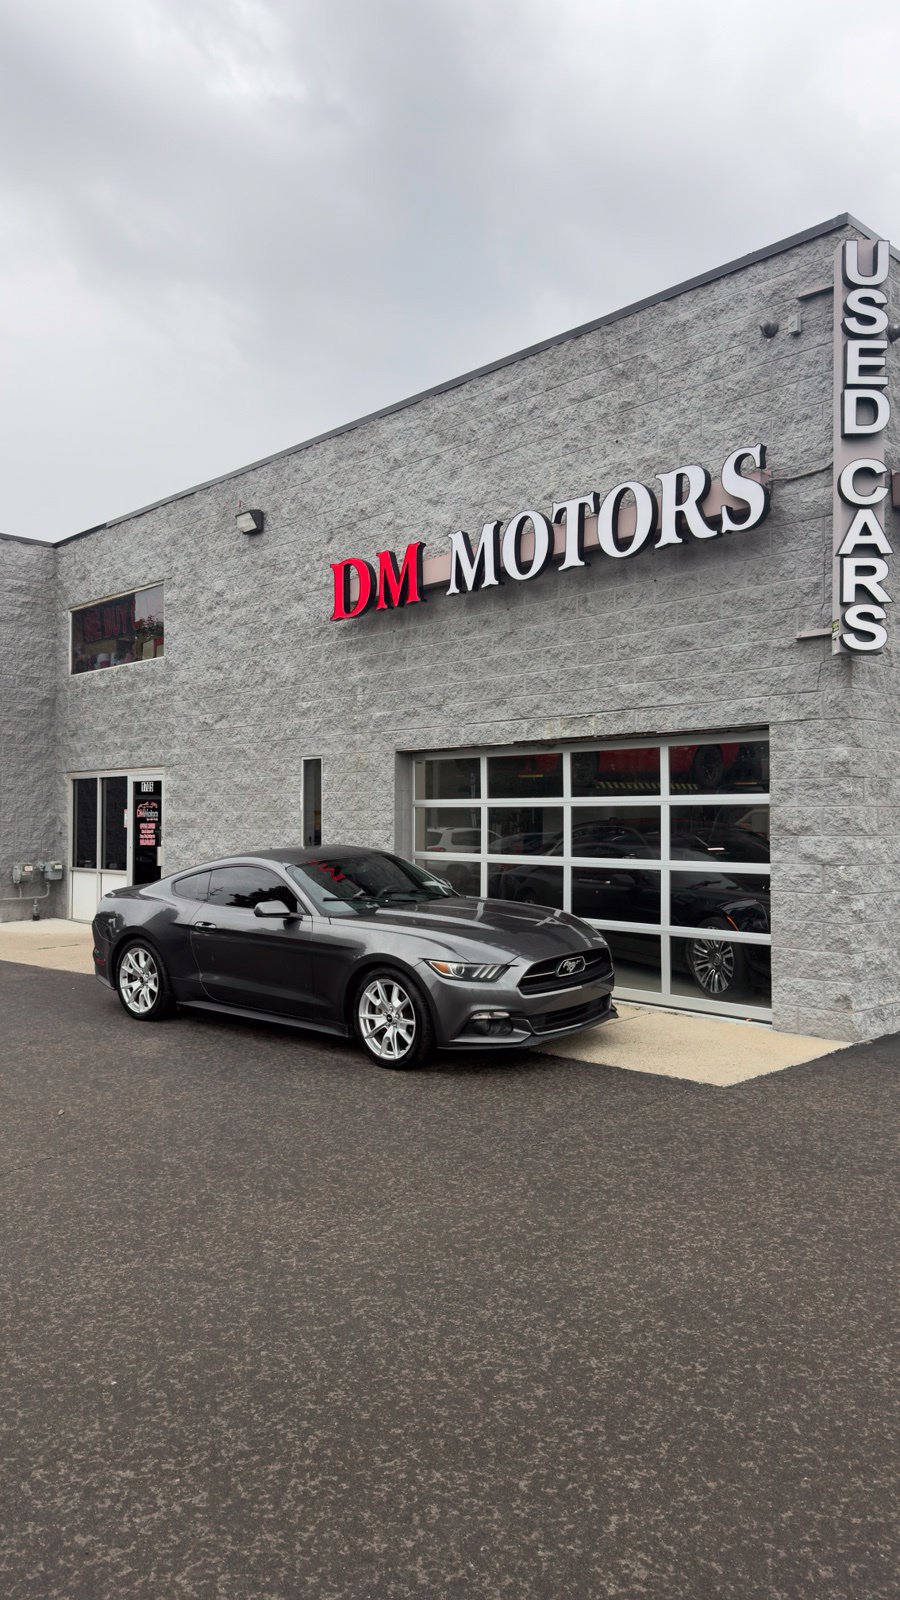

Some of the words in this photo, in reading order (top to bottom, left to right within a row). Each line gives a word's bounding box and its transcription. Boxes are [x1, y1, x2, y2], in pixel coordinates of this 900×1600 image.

[843, 240, 891, 435] USED
[330, 541, 426, 622] DM
[446, 443, 770, 596] MOTORS
[837, 458, 893, 650] CARS
